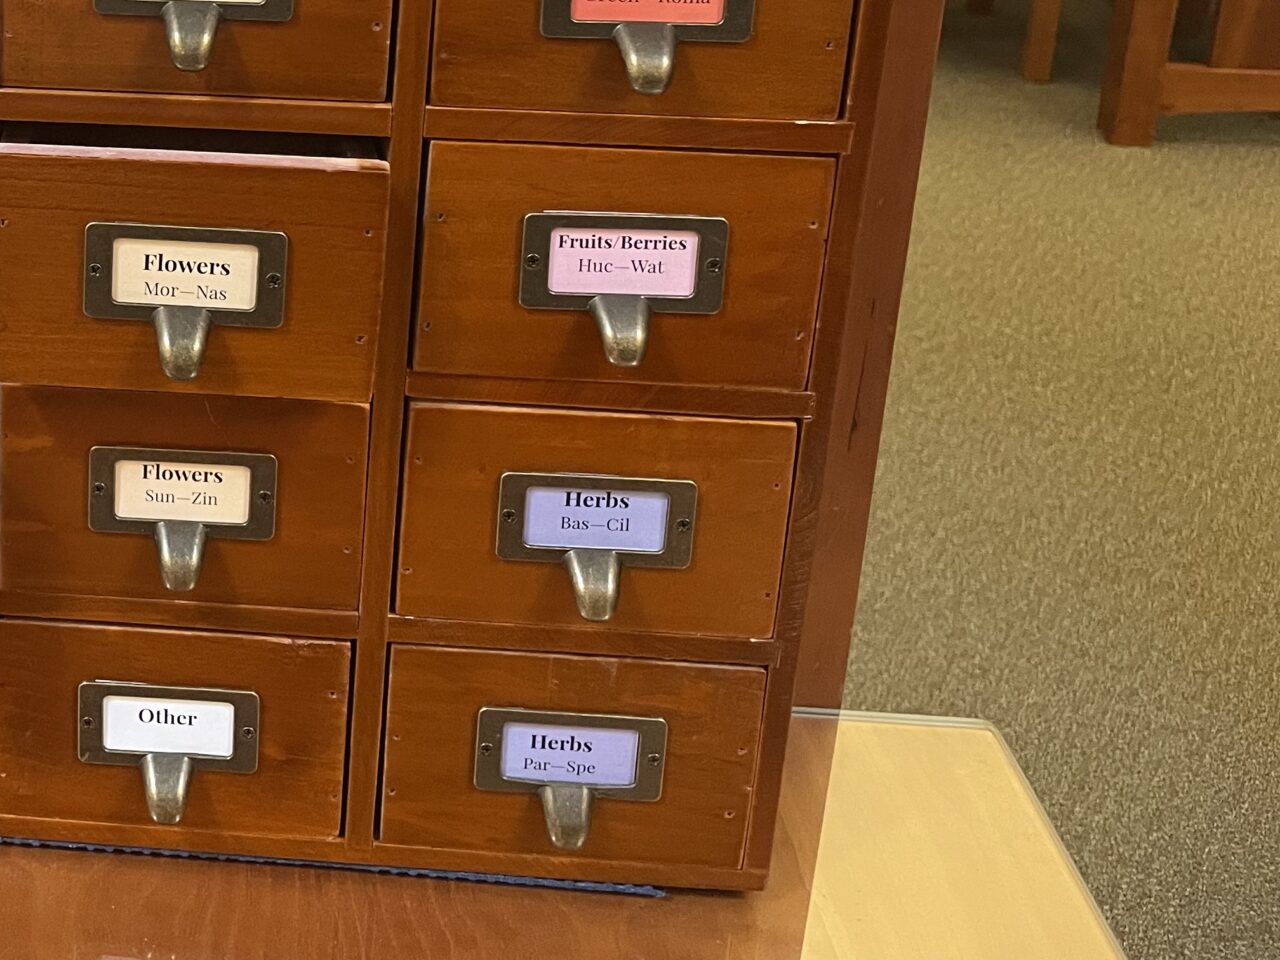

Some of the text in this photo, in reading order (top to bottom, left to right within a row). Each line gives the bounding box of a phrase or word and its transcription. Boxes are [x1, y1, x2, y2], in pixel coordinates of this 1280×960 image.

[558, 234, 688, 252] Fruits/Berries
[143, 254, 231, 276] Flowers
[142, 463, 224, 484] Flowers
[564, 490, 630, 510] Herbs
[138, 708, 198, 727] Other
[530, 734, 594, 754] Herbs
